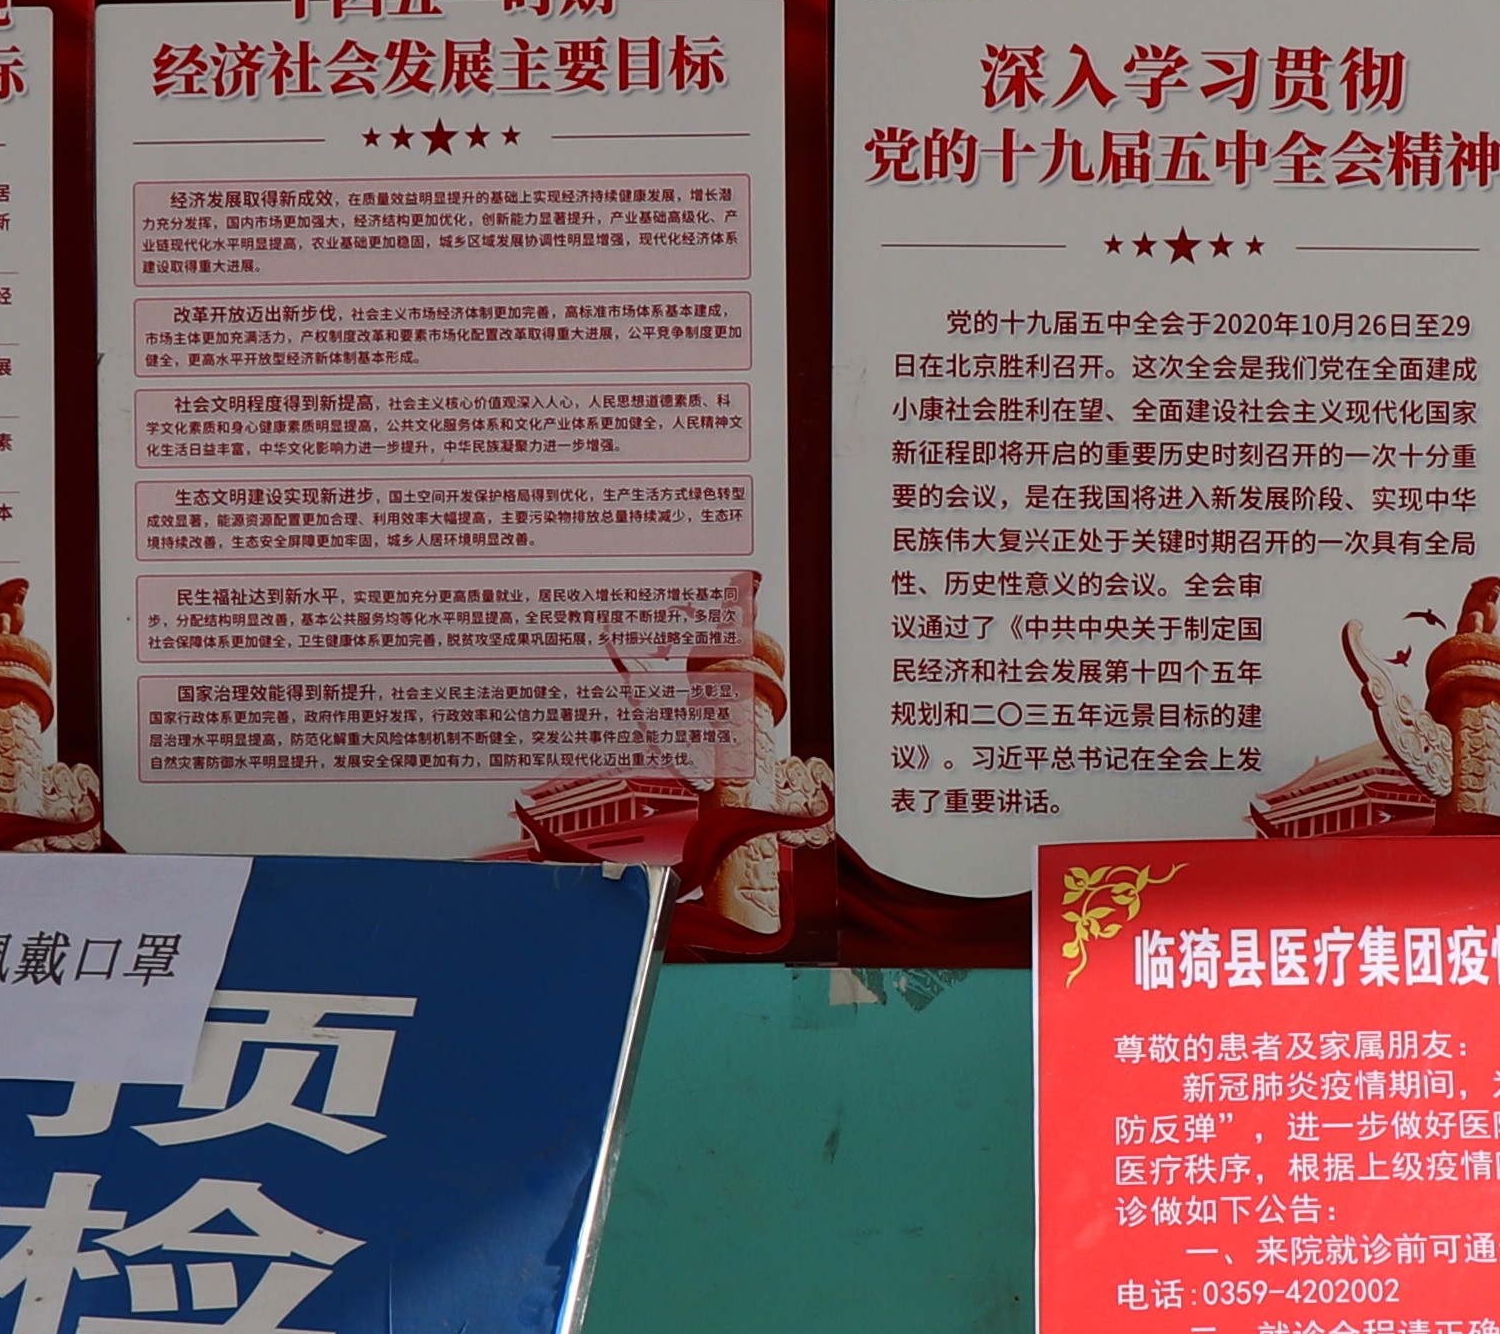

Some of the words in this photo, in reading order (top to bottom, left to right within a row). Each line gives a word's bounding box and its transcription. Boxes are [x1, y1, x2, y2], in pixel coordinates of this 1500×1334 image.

[153, 36, 724, 97] 经济社会发展主要目标
[981, 44, 1405, 110] 深入学习贯彻
[865, 128, 1500, 186] 党的十九届五中全会精神
[143, 259, 259, 273] 建设取得重大进展。
[947, 310, 1470, 337] 党的十九届五中全会于2020年10月26日至29
[896, 354, 1477, 381] 日在北京胜利召开。这次全会是我们党在全面建成
[893, 397, 1476, 424] 小康社会胜利在望、全面建设社会主义现代化国家
[893, 441, 1476, 468] 新征程即将开启的重要历史时刻召开的一次十分重
[893, 484, 1476, 511] 要的会议，是在我国将进入新发展阶段、实现中华
[894, 527, 1475, 555] 民族伟大复兴正处于关键时期召开的一次具有全局
[892, 571, 1262, 597] 性、历史性意义的会议。全会审
[892, 614, 1261, 640] 议通过了《中共中央关于制定国
[893, 658, 1262, 684] 民经济和社会发展第十四个五年
[891, 745, 1261, 771] 议》。习近平总书记在全会上发
[892, 788, 1059, 814] 表了重要讲话。
